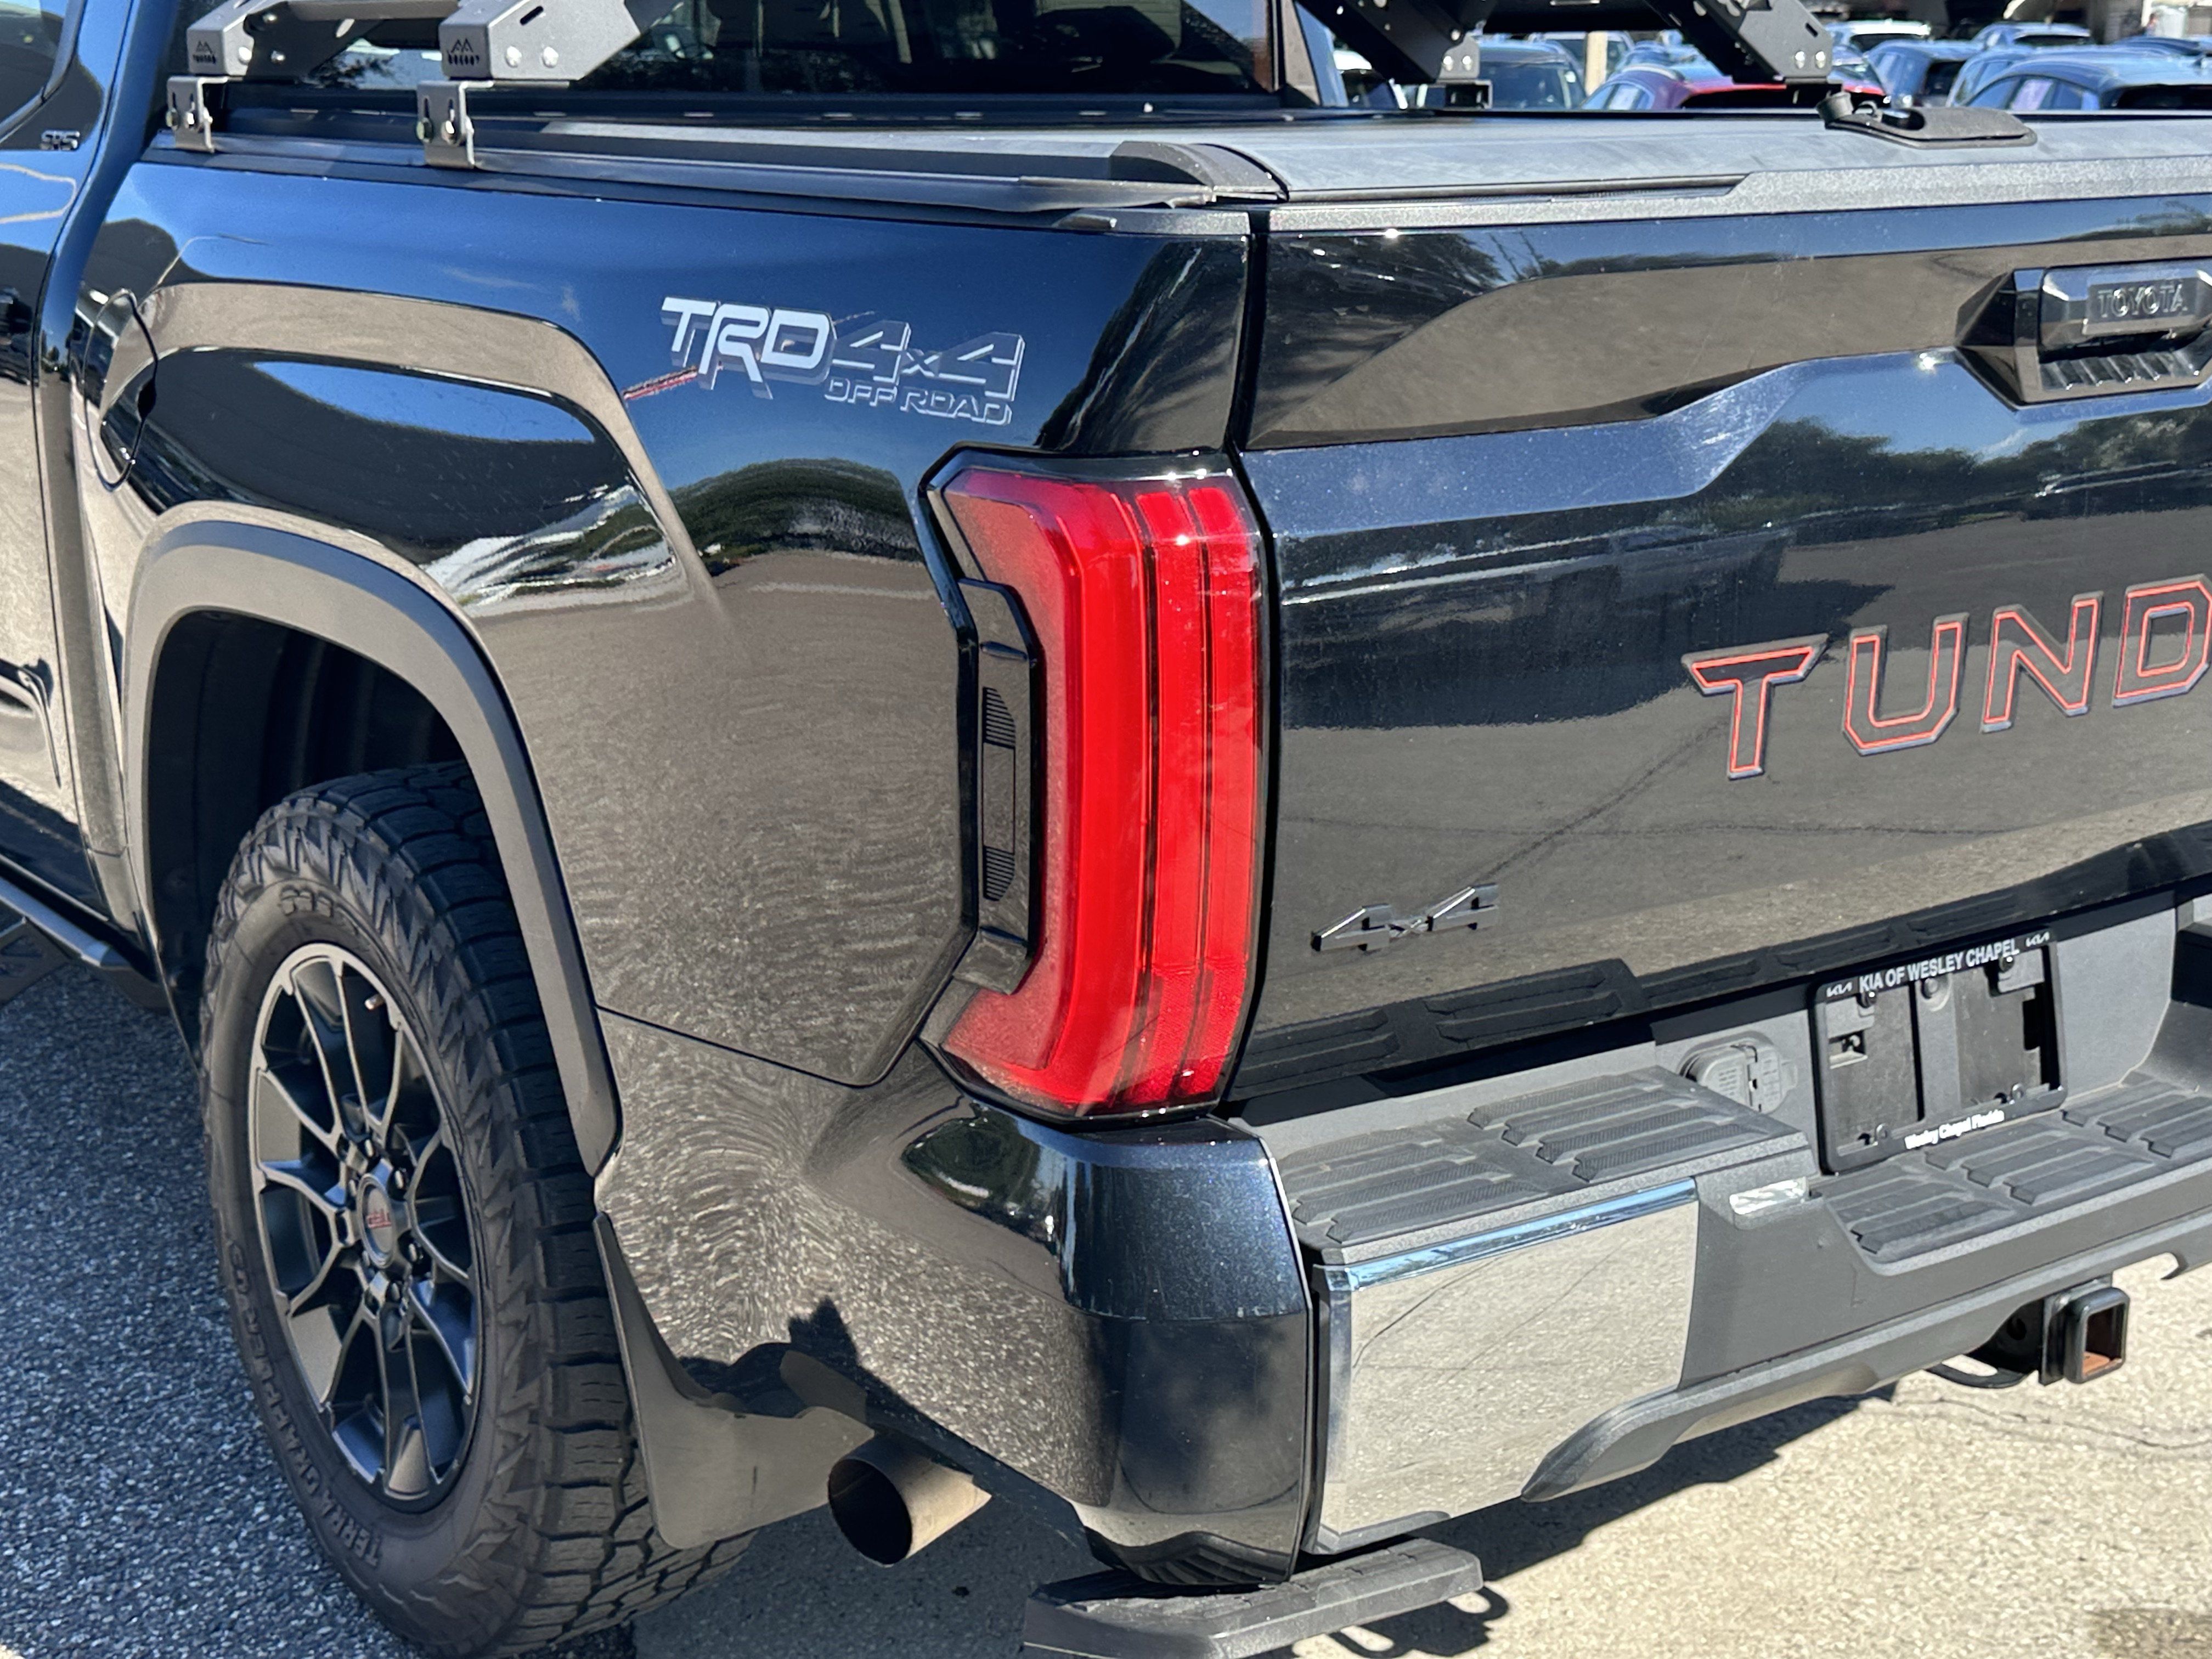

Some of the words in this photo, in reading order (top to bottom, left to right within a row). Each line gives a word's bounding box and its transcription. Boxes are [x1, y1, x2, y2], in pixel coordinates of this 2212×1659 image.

[2097, 283, 2188, 318] TOYOTA
[662, 297, 836, 399] TRD
[832, 320, 1025, 402] 4x4
[825, 378, 898, 407] OFF
[900, 390, 1012, 425] ROAD
[1311, 883, 1499, 952] 4x4
[1859, 972, 1883, 993] KIA
[1885, 966, 1905, 987] OF
[1907, 951, 1964, 981] WESLEY
[1966, 939, 2019, 967] CHAPEL
[321, 1489, 383, 1567] TERRA
